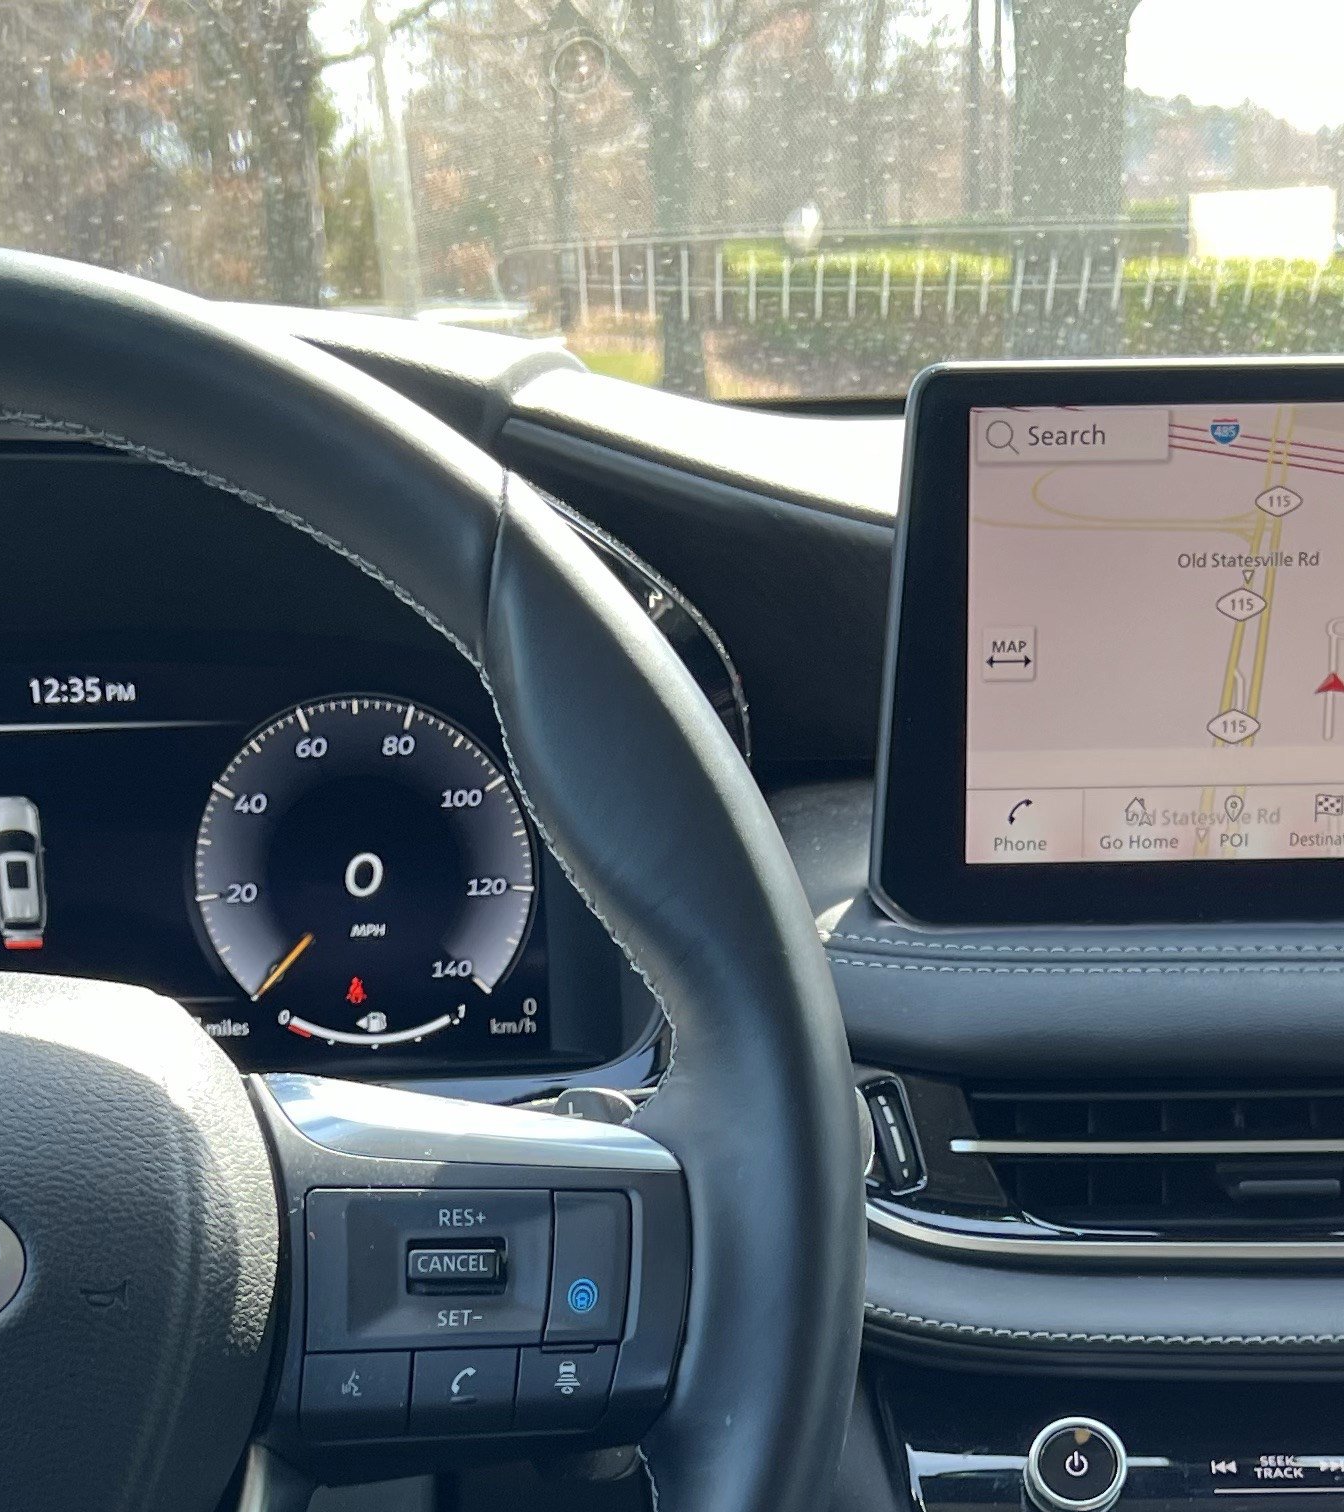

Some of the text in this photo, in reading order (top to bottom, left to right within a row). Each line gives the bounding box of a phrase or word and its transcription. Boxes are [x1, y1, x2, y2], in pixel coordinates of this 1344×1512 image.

[1027, 425, 1107, 447] Search
[1268, 495, 1291, 508] 115
[1177, 551, 1320, 569] Old Statesville Rd
[1230, 597, 1254, 612] 115
[991, 639, 1027, 654] MAP
[29, 676, 136, 704] 12:35 PM
[1221, 720, 1247, 733] 115
[295, 737, 328, 759] 60
[382, 735, 416, 757] 80
[234, 793, 268, 814] 40
[440, 789, 484, 809] 100
[993, 837, 1047, 852] Phone
[1099, 833, 1179, 850] Go Home
[1219, 833, 1249, 849] POI
[345, 852, 383, 897] 0
[226, 882, 258, 904] 20
[467, 876, 507, 896] 120
[350, 922, 386, 939] MPH
[431, 959, 473, 979] 140
[523, 998, 537, 1016] 0
[277, 1009, 291, 1026] 0
[490, 1018, 537, 1035] km/h
[207, 1020, 250, 1037] miles
[439, 1208, 487, 1228] RES+
[417, 1254, 489, 1273] CANCEL
[1259, 1454, 1297, 1468] SEEK
[1254, 1466, 1304, 1479] TRACK
